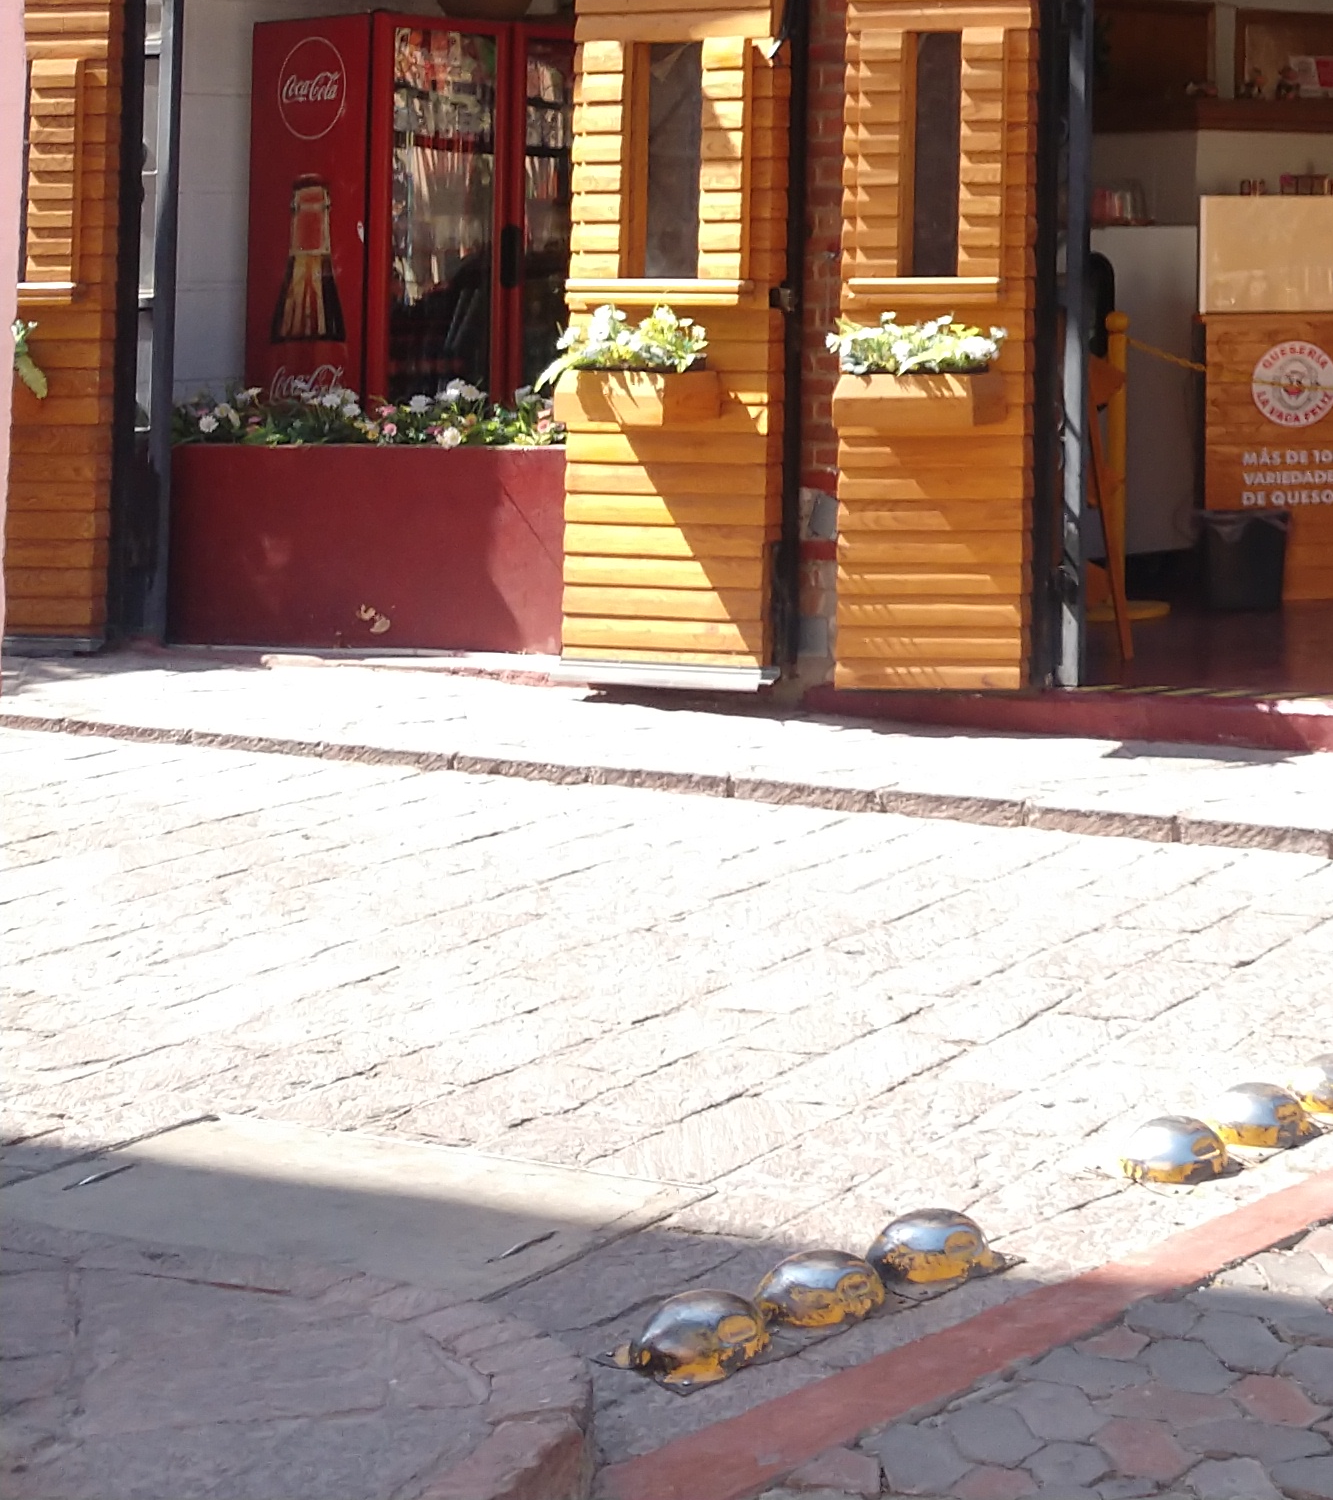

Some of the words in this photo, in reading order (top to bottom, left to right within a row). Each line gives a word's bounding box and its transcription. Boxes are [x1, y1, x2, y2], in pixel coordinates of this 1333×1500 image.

[1243, 446, 1281, 467] MÁS
[1285, 449, 1309, 466] DE
[1242, 491, 1266, 507] DE
